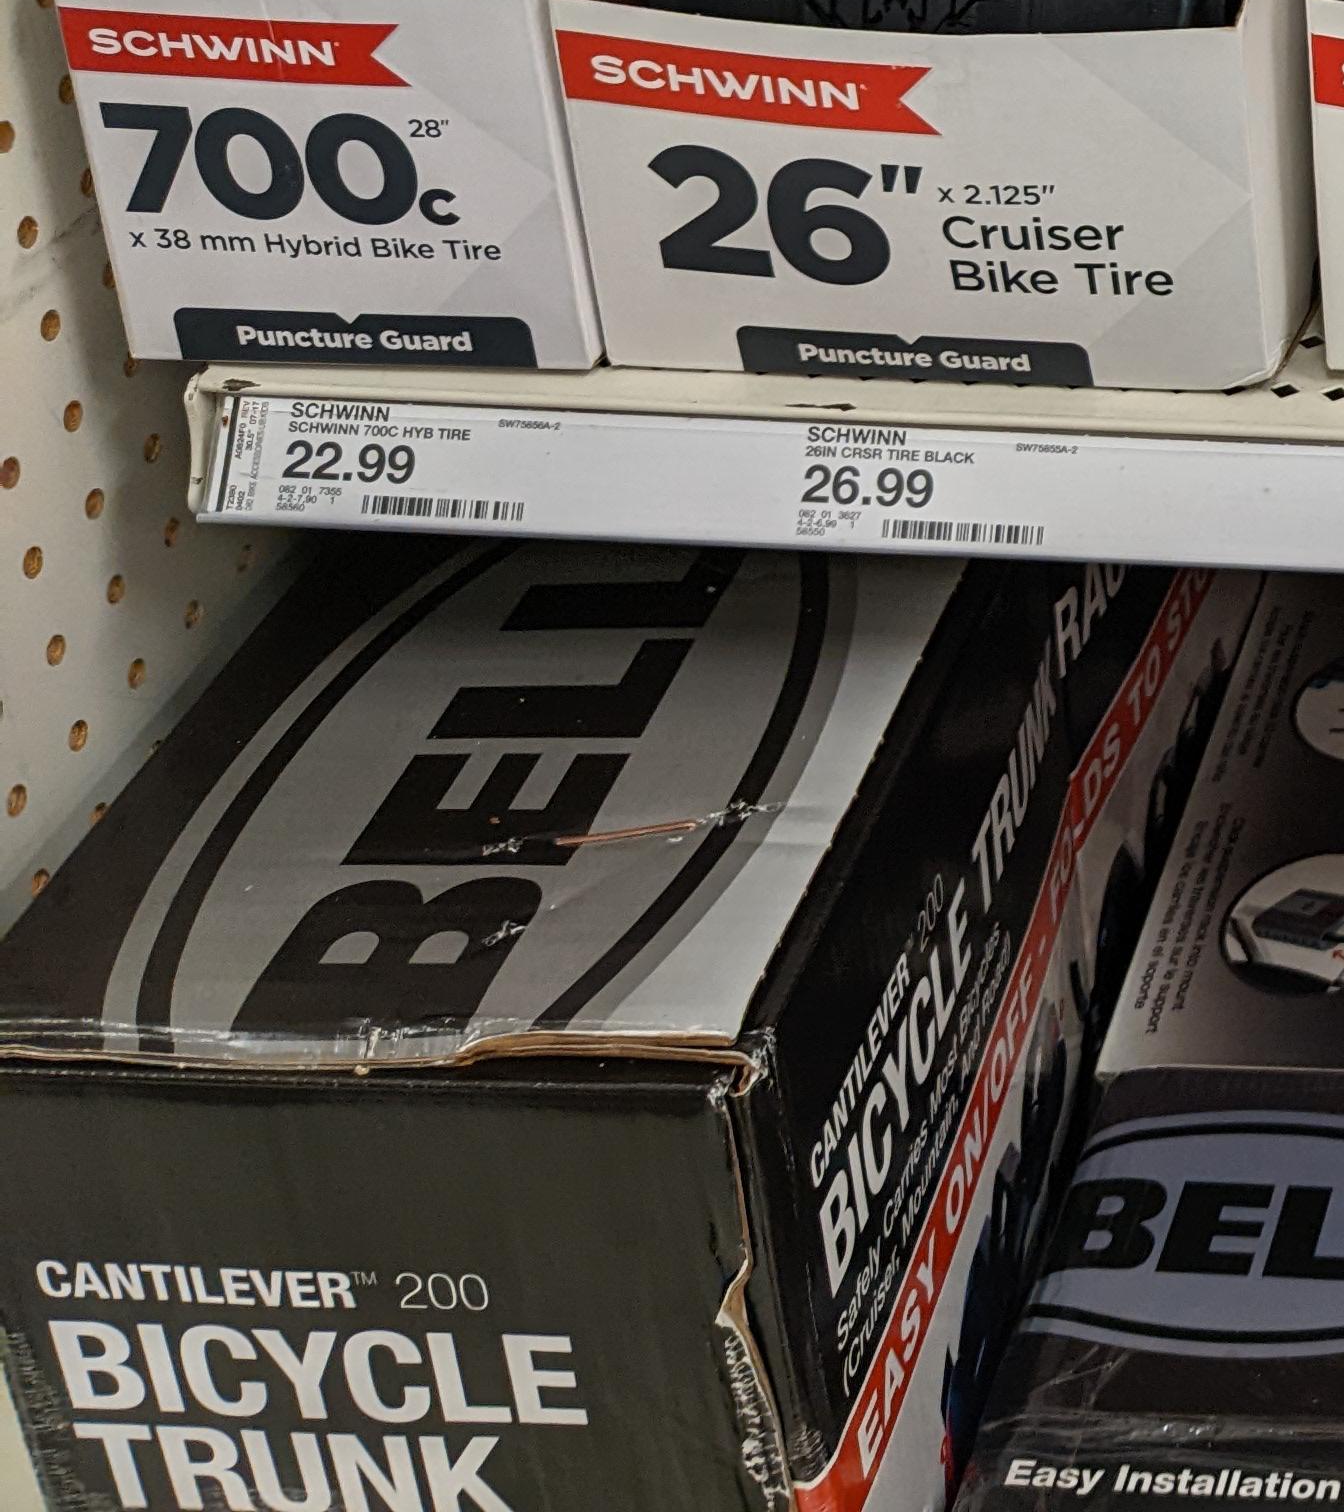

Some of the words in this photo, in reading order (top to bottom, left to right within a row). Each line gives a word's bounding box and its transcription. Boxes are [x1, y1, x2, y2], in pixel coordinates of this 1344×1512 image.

[88, 24, 339, 69] SCHWINN
[591, 52, 860, 112] SCHWINN
[937, 185, 956, 205] x
[129, 231, 148, 250] x
[153, 227, 192, 253] 38
[200, 231, 257, 255] mm
[264, 231, 365, 262] Hybrid
[372, 236, 435, 261] Bike
[442, 237, 503, 263] Tire
[942, 214, 1125, 253] Cruiser
[948, 258, 1059, 295] Bike
[1073, 262, 1175, 297] Tire
[235, 324, 377, 352] Puncture
[382, 327, 473, 355] Guard
[798, 342, 933, 371] Puncture
[938, 348, 1032, 376] Guard
[288, 421, 360, 436] SCHWINN
[363, 423, 399, 438] 700C
[401, 425, 434, 440] HYB
[438, 428, 471, 441] TIRE
[290, 401, 391, 423] SCHWINN
[805, 445, 837, 458] 26IN
[841, 447, 883, 461] CRSR
[887, 449, 920, 462] TIRE
[924, 451, 975, 465] BLACK
[807, 426, 907, 446] SCHWINN
[281, 439, 416, 485] 22.99
[801, 463, 934, 509] 26.99
[229, 552, 746, 1034] BELL
[856, 1236, 938, 1479] EASY
[944, 953, 1034, 1234] ON/OFF
[398, 1271, 490, 1313] 200
[47, 1318, 589, 1428] BICYCLE
[73, 1420, 513, 1512] TRUNK
